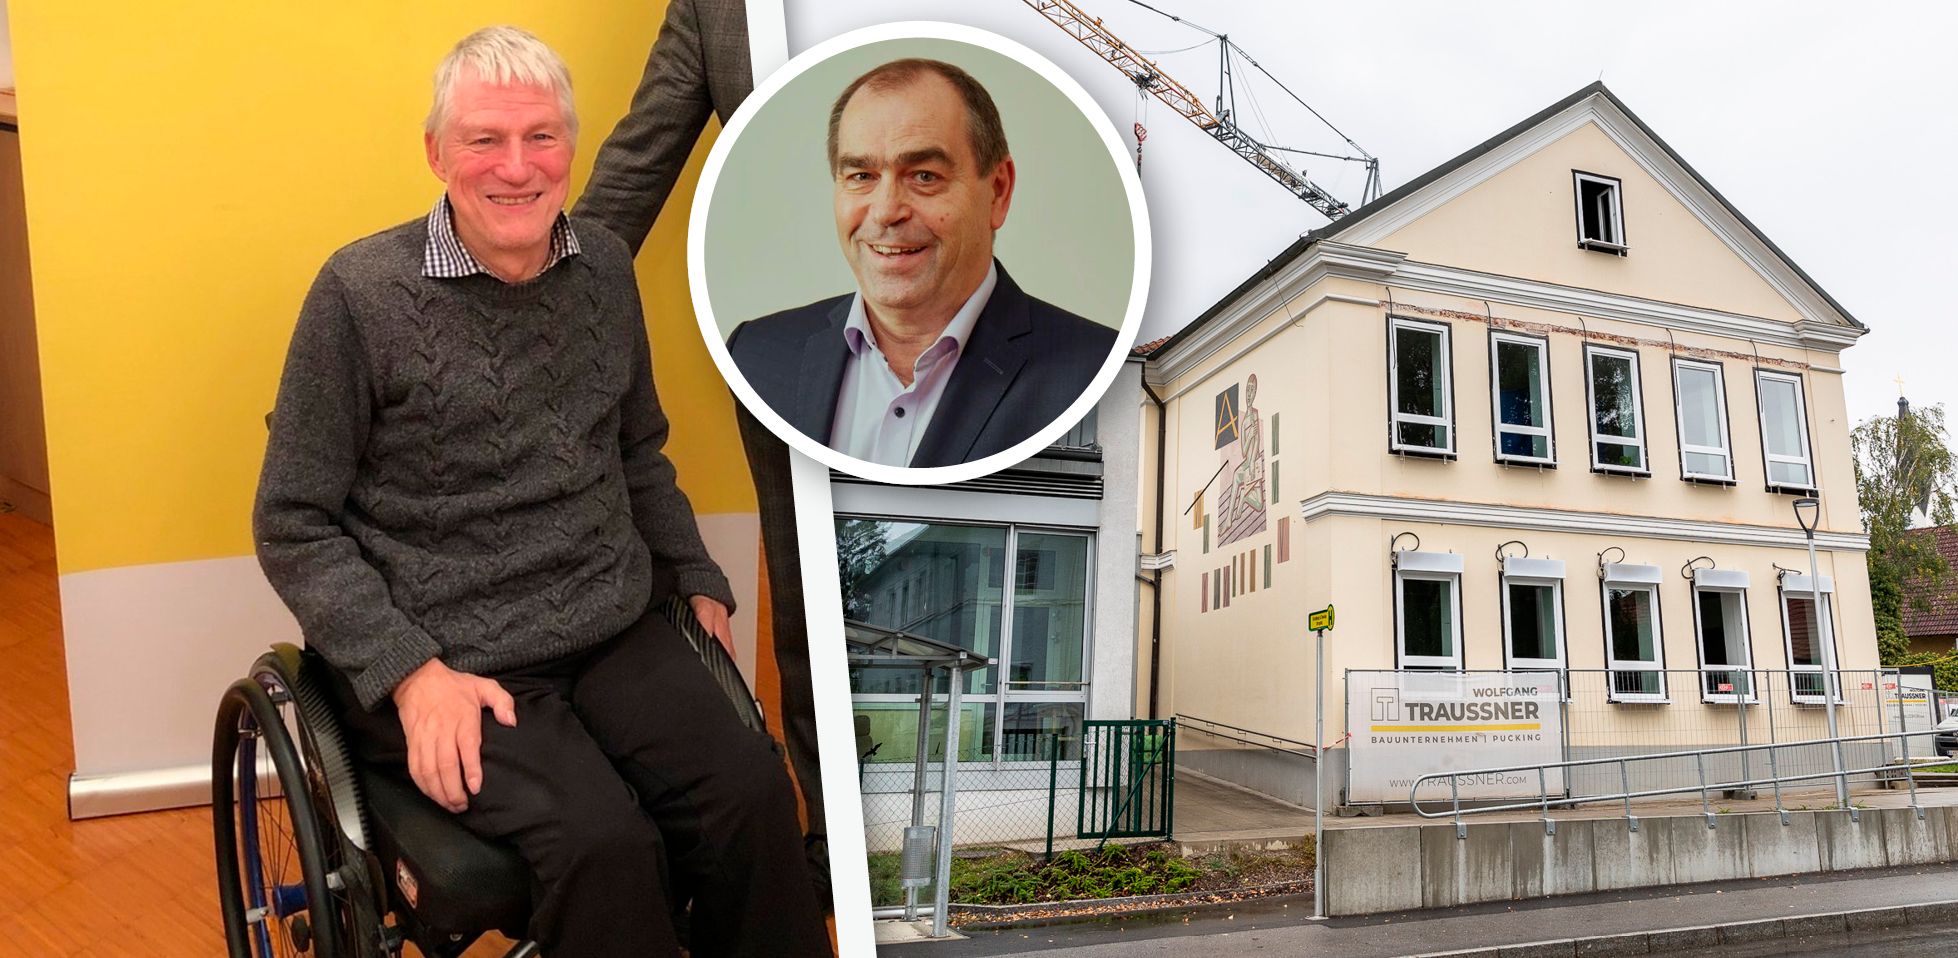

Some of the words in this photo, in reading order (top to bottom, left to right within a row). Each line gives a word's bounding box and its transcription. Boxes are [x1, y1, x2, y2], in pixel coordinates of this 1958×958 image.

[1215, 391, 1239, 450] A
[1473, 687, 1538, 698] WOLFGANG
[1894, 692, 1927, 700] TAUSSNER
[1404, 701, 1540, 721] TRAUSSNER
[1371, 735, 1478, 744] BAUUNTERNEHMEN
[1492, 733, 1541, 743] PUCKING
